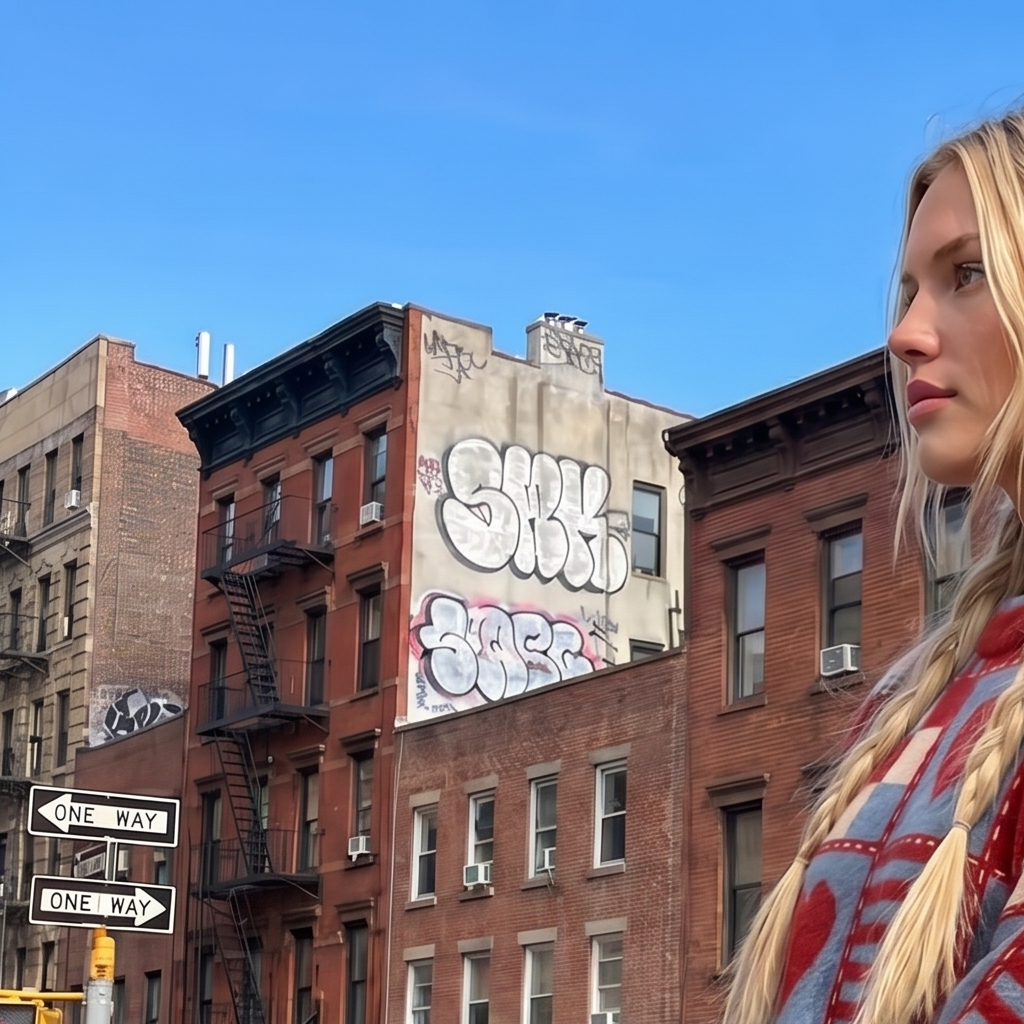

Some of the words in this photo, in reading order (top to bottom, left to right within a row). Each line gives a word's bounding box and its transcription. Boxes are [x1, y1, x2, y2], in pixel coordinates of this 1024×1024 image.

[55, 804, 95, 824] ONE
[117, 810, 157, 829] WAY
[51, 892, 91, 911] ONE
[111, 897, 151, 916] WAY
